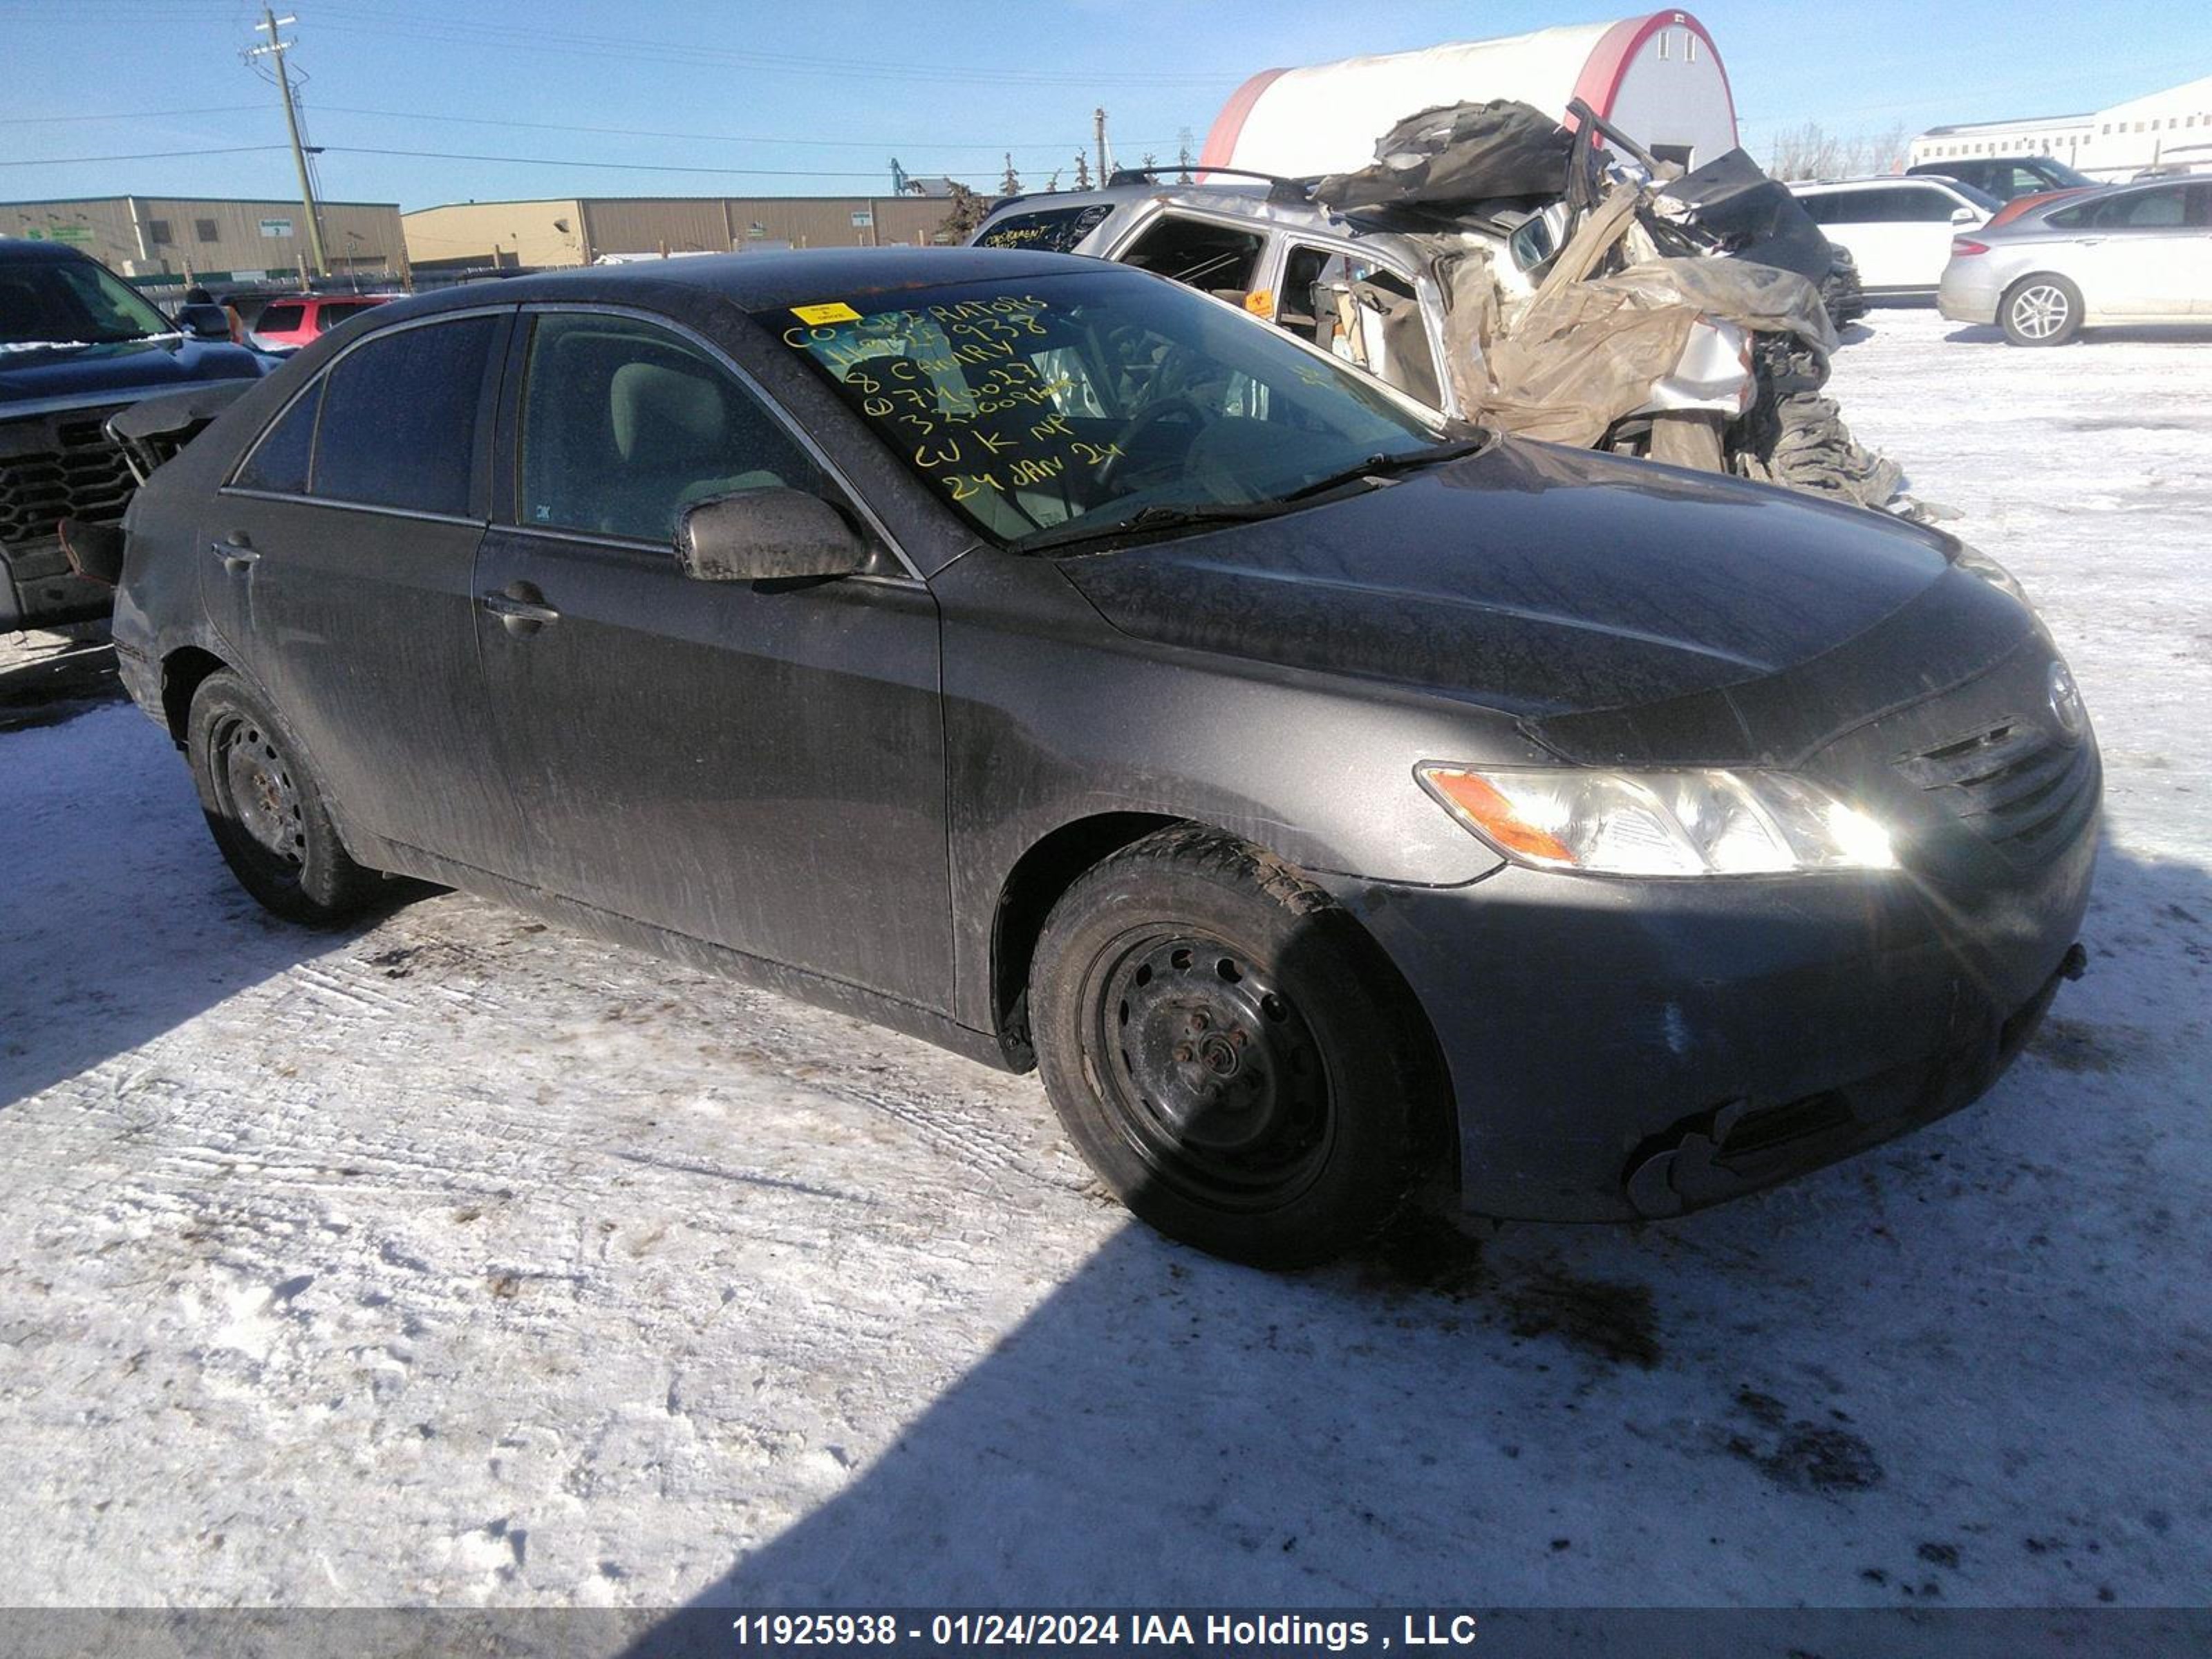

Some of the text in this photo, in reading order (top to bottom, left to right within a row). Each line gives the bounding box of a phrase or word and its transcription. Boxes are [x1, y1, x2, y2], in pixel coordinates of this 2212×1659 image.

[891, 339, 1014, 379] CAMRY
[941, 442, 1127, 500] 24 JAN 24
